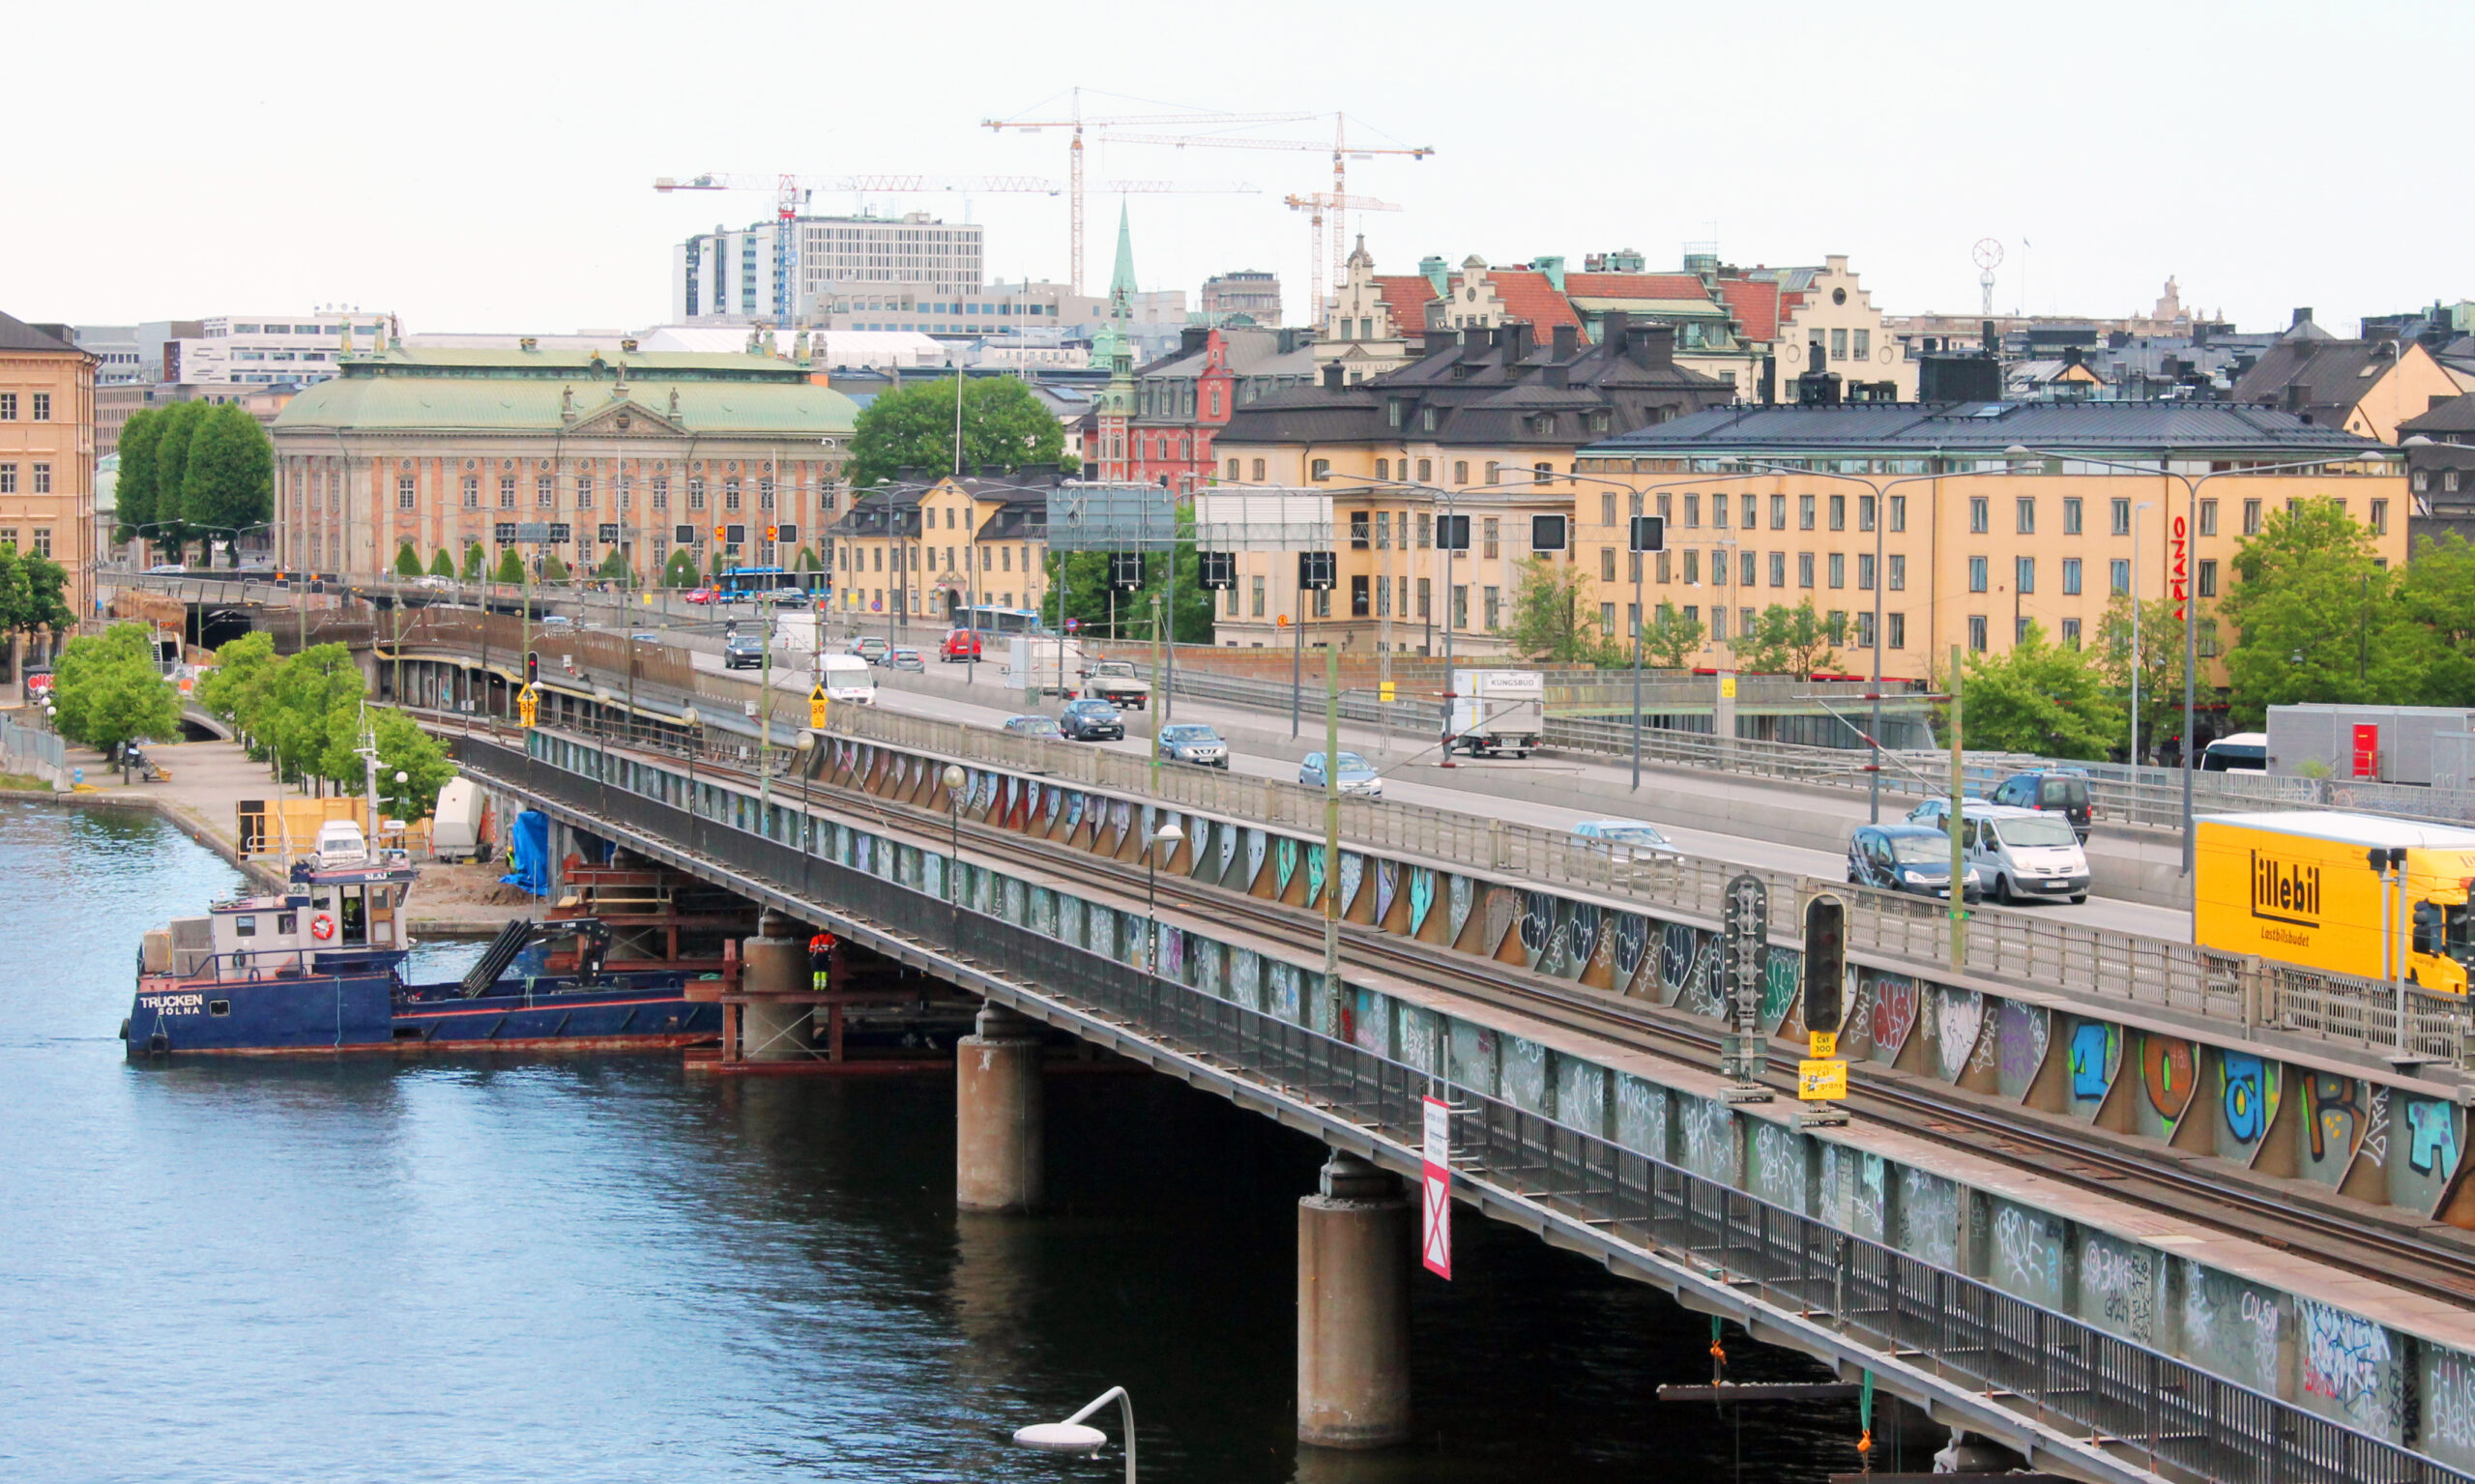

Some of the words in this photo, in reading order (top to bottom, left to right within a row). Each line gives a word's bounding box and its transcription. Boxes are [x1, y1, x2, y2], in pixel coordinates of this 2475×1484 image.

[812, 704, 825, 713] 30
[2260, 925, 2310, 947] Lastbilsbudet
[139, 994, 203, 1008] TRUCKEN
[158, 1006, 200, 1016] SOLNA
